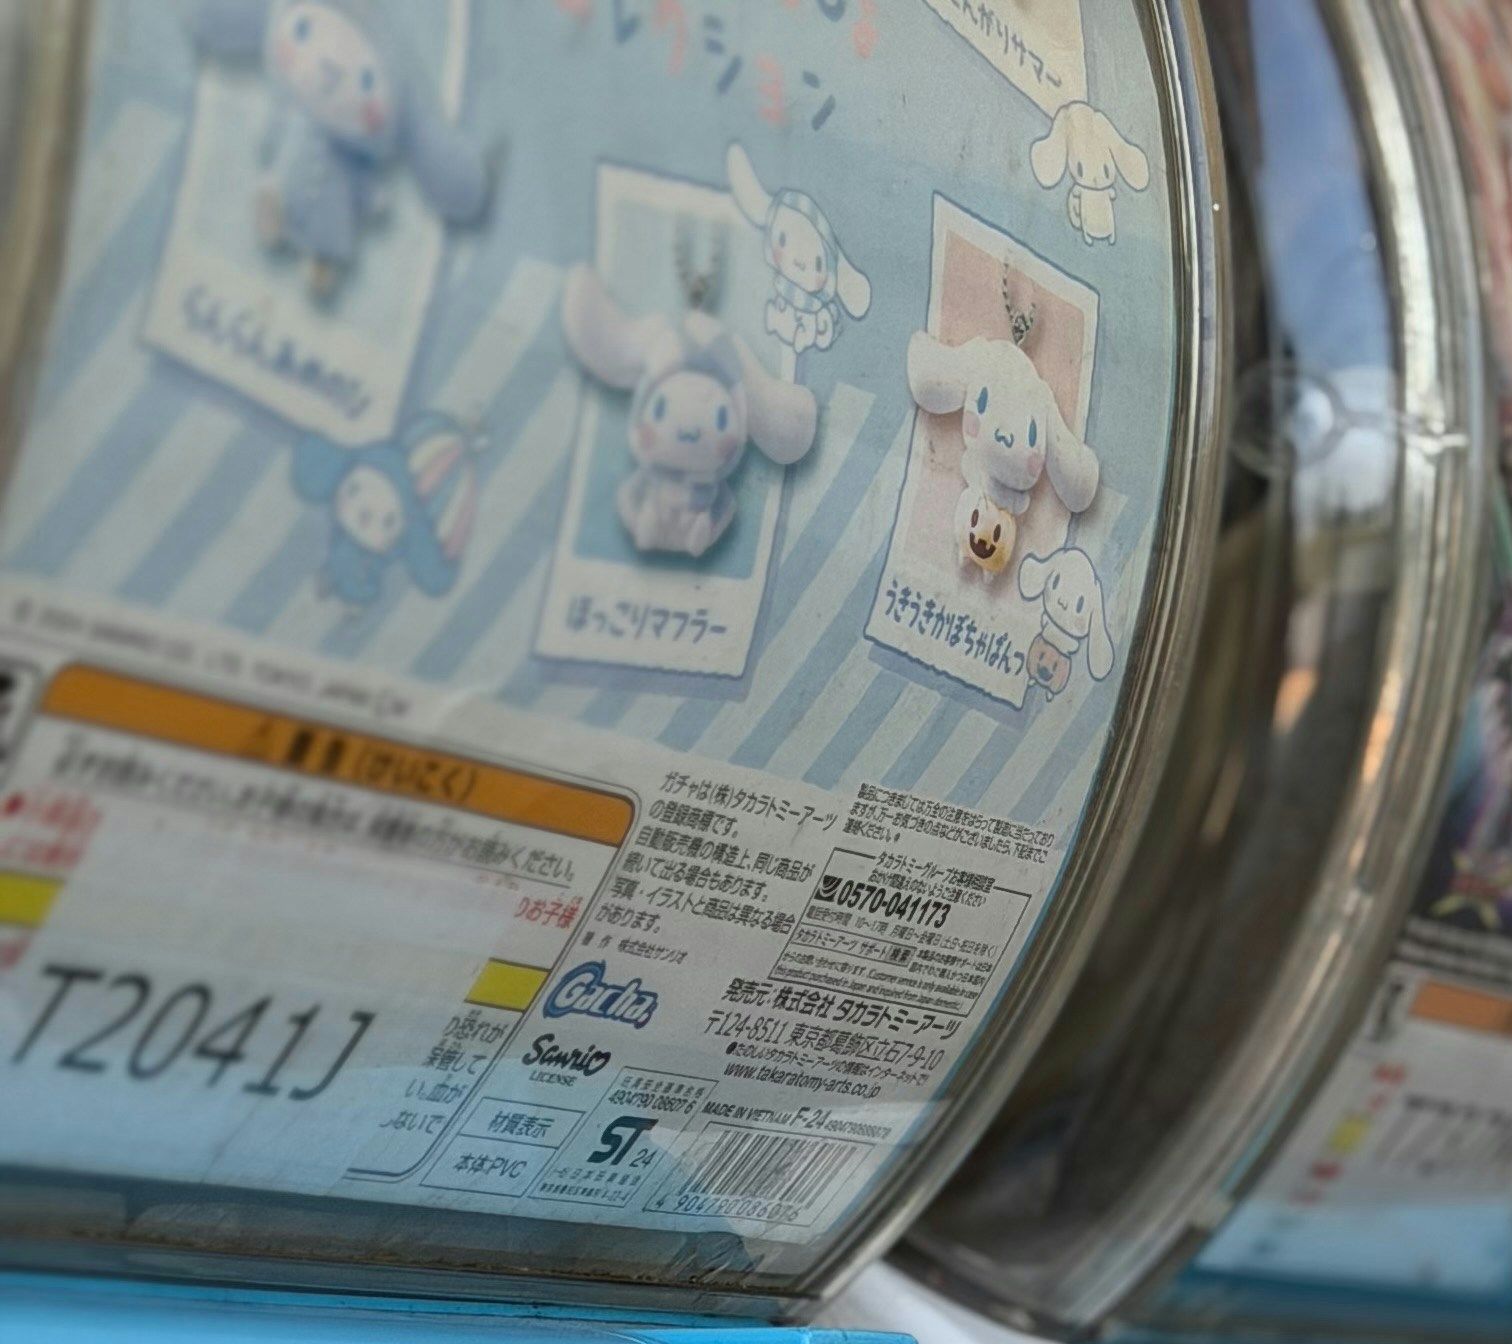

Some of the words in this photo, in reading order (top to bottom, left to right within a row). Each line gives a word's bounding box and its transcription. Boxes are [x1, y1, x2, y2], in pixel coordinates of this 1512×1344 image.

[832, 879, 954, 929] 0570-041173
[10, 963, 377, 1101] T2041J
[833, 998, 962, 1041] タカラトミーアーツ
[522, 1033, 611, 1077] Sanrio
[529, 1070, 578, 1087] LICENSE
[723, 1063, 881, 1099] www.takaratomy-arts.co.jp
[587, 1115, 658, 1165] ST
[630, 1149, 655, 1169] 24
